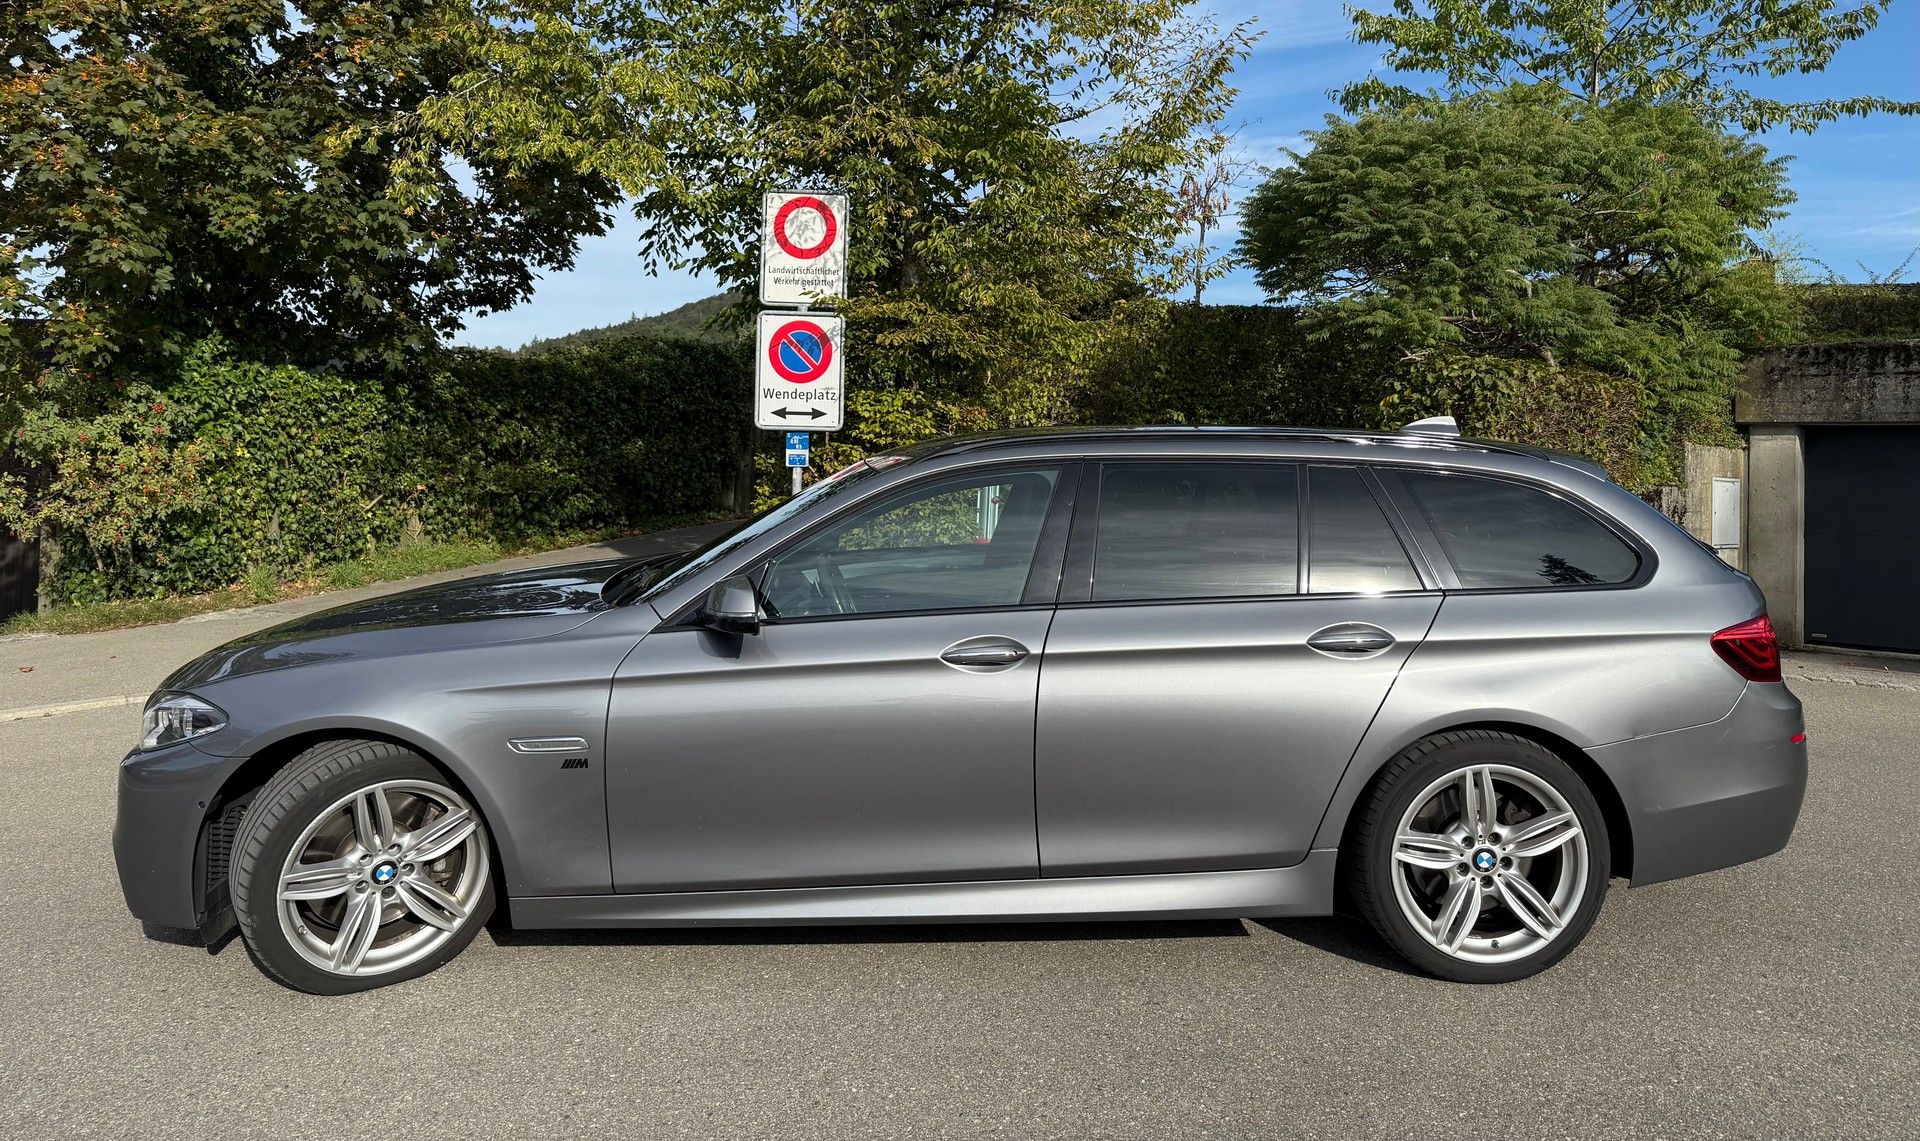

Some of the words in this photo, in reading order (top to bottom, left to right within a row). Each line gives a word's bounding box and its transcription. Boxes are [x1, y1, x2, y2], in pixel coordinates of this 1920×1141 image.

[768, 265, 840, 276] Landwirtschaftlicher
[773, 276, 800, 285] Verkehr
[801, 279, 834, 288] gestattet
[763, 388, 836, 403] Wendeplatz
